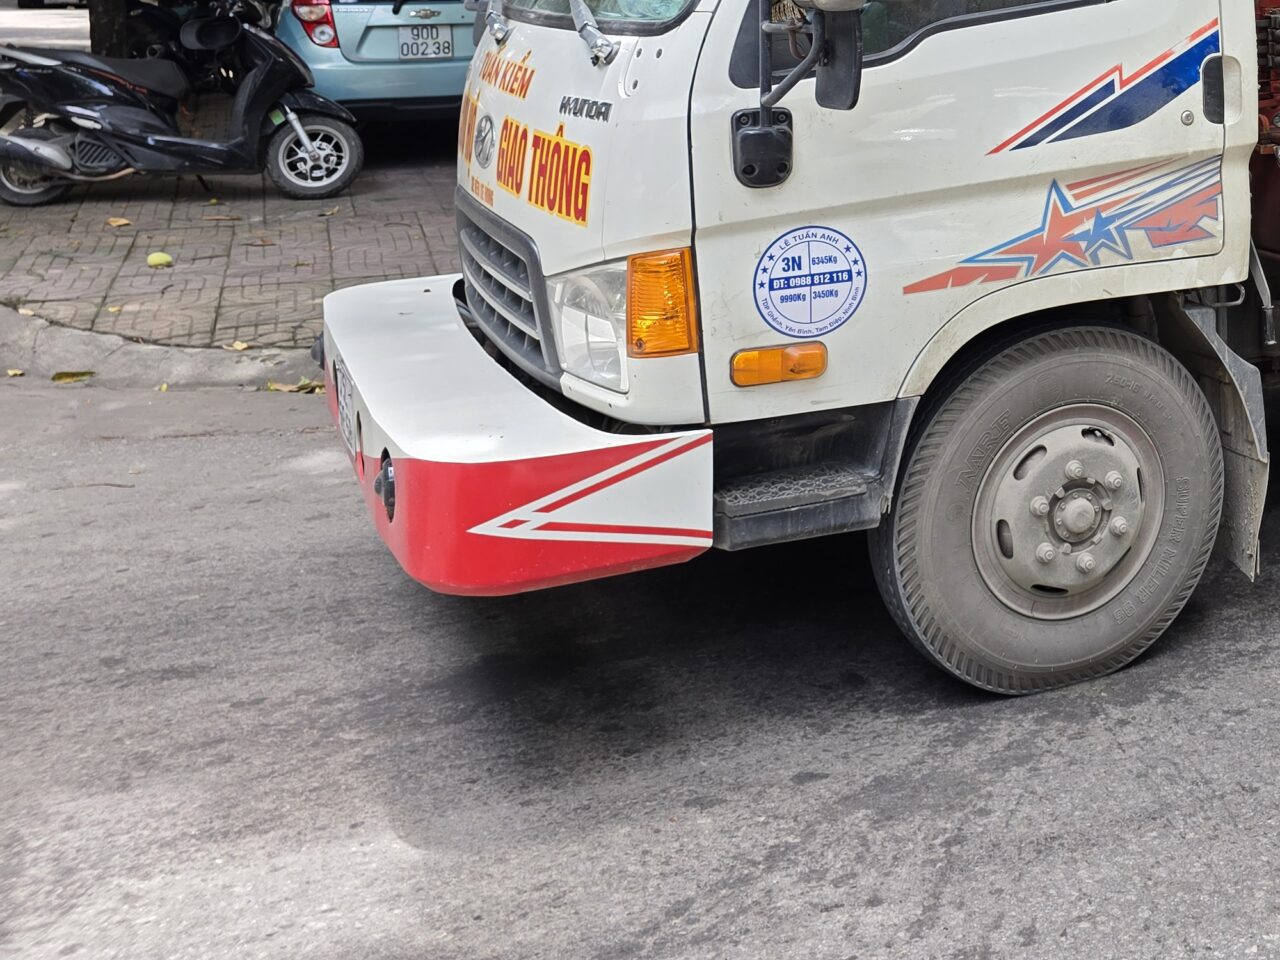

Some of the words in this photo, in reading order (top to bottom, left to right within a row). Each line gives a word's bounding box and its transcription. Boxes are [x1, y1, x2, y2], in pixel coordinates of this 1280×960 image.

[411, 26, 439, 40] 90D
[401, 41, 451, 56] 002.38
[559, 96, 613, 123] HYUNDAI
[496, 118, 529, 195] GIAO
[527, 121, 592, 223] THÔNG
[779, 239, 791, 251] LÊ
[792, 231, 818, 243] TUẤN
[820, 232, 840, 245] ANH
[781, 255, 802, 273] 3N
[773, 279, 788, 289] ĐT:
[789, 276, 812, 287] 0988
[813, 274, 831, 284] 812
[832, 271, 849, 281] 116
[1169, 475, 1191, 544] SUPER
[1136, 548, 1177, 604] MILER
